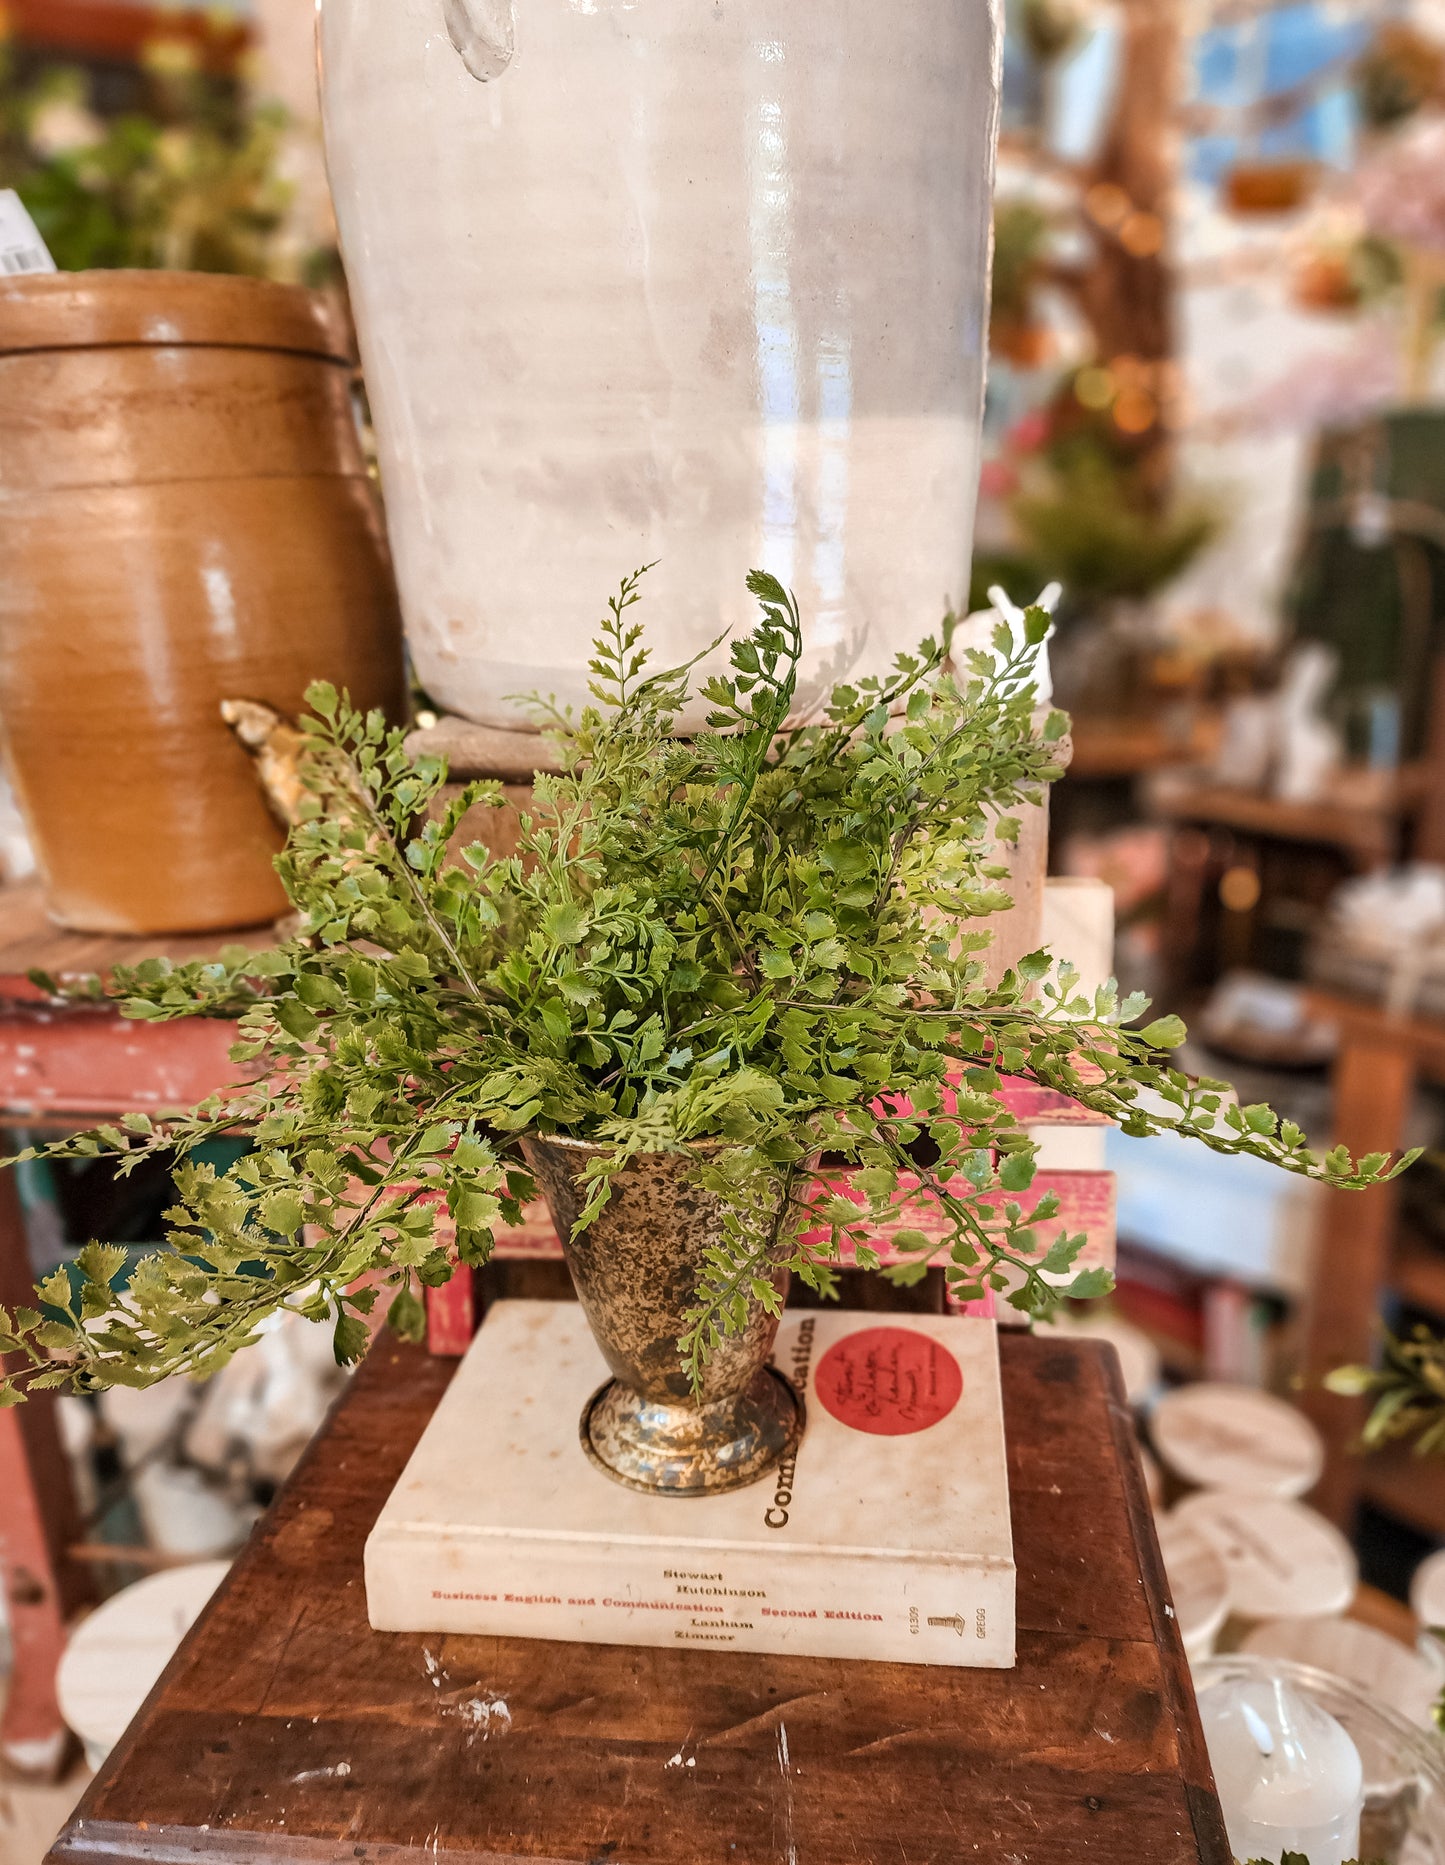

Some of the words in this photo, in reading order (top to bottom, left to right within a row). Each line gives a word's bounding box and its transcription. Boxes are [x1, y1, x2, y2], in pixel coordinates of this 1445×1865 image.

[662, 1569, 724, 1582] Stewart
[676, 1584, 767, 1599] Hutchinson
[431, 1590, 498, 1601] Business
[503, 1593, 562, 1605] English
[567, 1597, 597, 1606] and
[602, 1597, 725, 1613] Communication
[761, 1607, 818, 1619] Second
[823, 1609, 884, 1622] Edition
[690, 1617, 755, 1630] Lanham
[908, 1606, 919, 1635] 61309
[975, 1607, 987, 1640] GREGG
[673, 1630, 736, 1642] Zimmer
